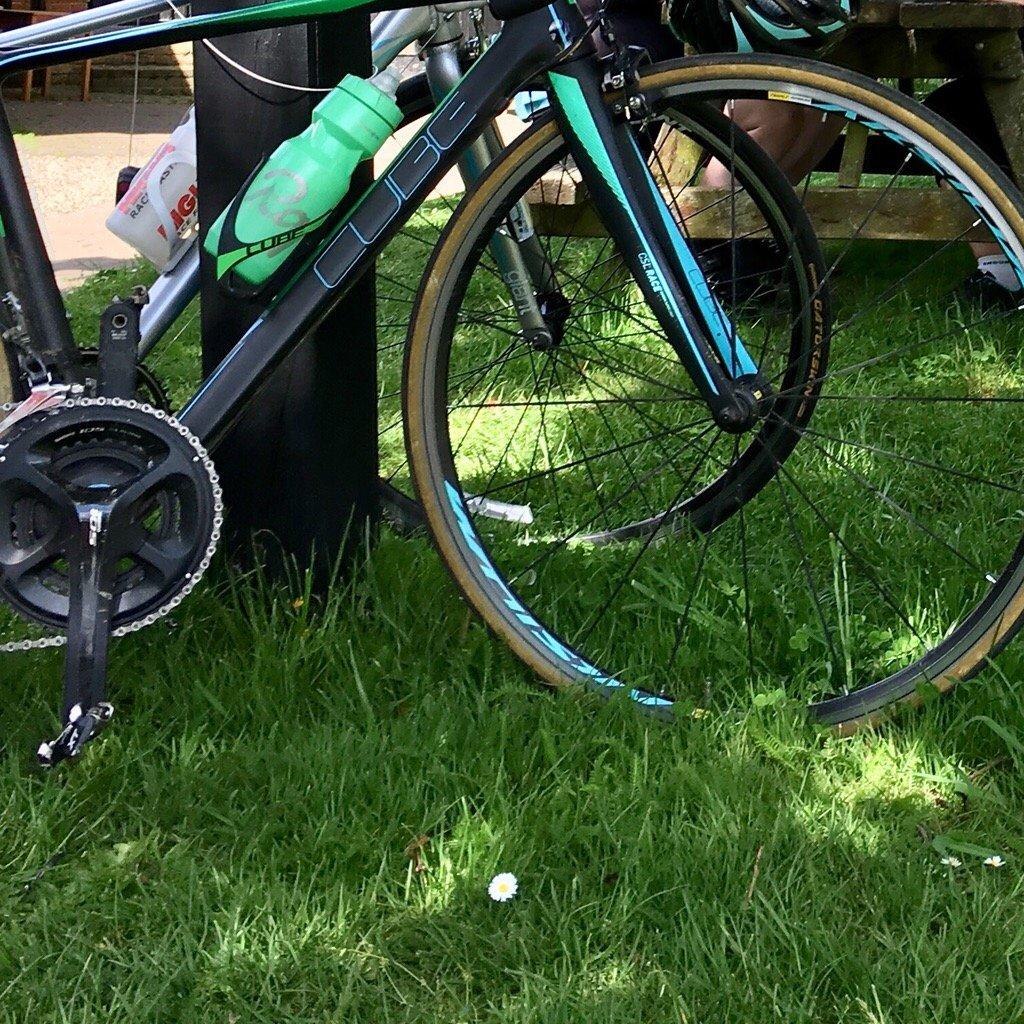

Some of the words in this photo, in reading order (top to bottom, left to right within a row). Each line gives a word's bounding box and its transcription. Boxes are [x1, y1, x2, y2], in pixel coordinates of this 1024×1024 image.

[129, 191, 149, 219] RAC
[246, 227, 307, 255] CUBE
[645, 266, 662, 293] RACE
